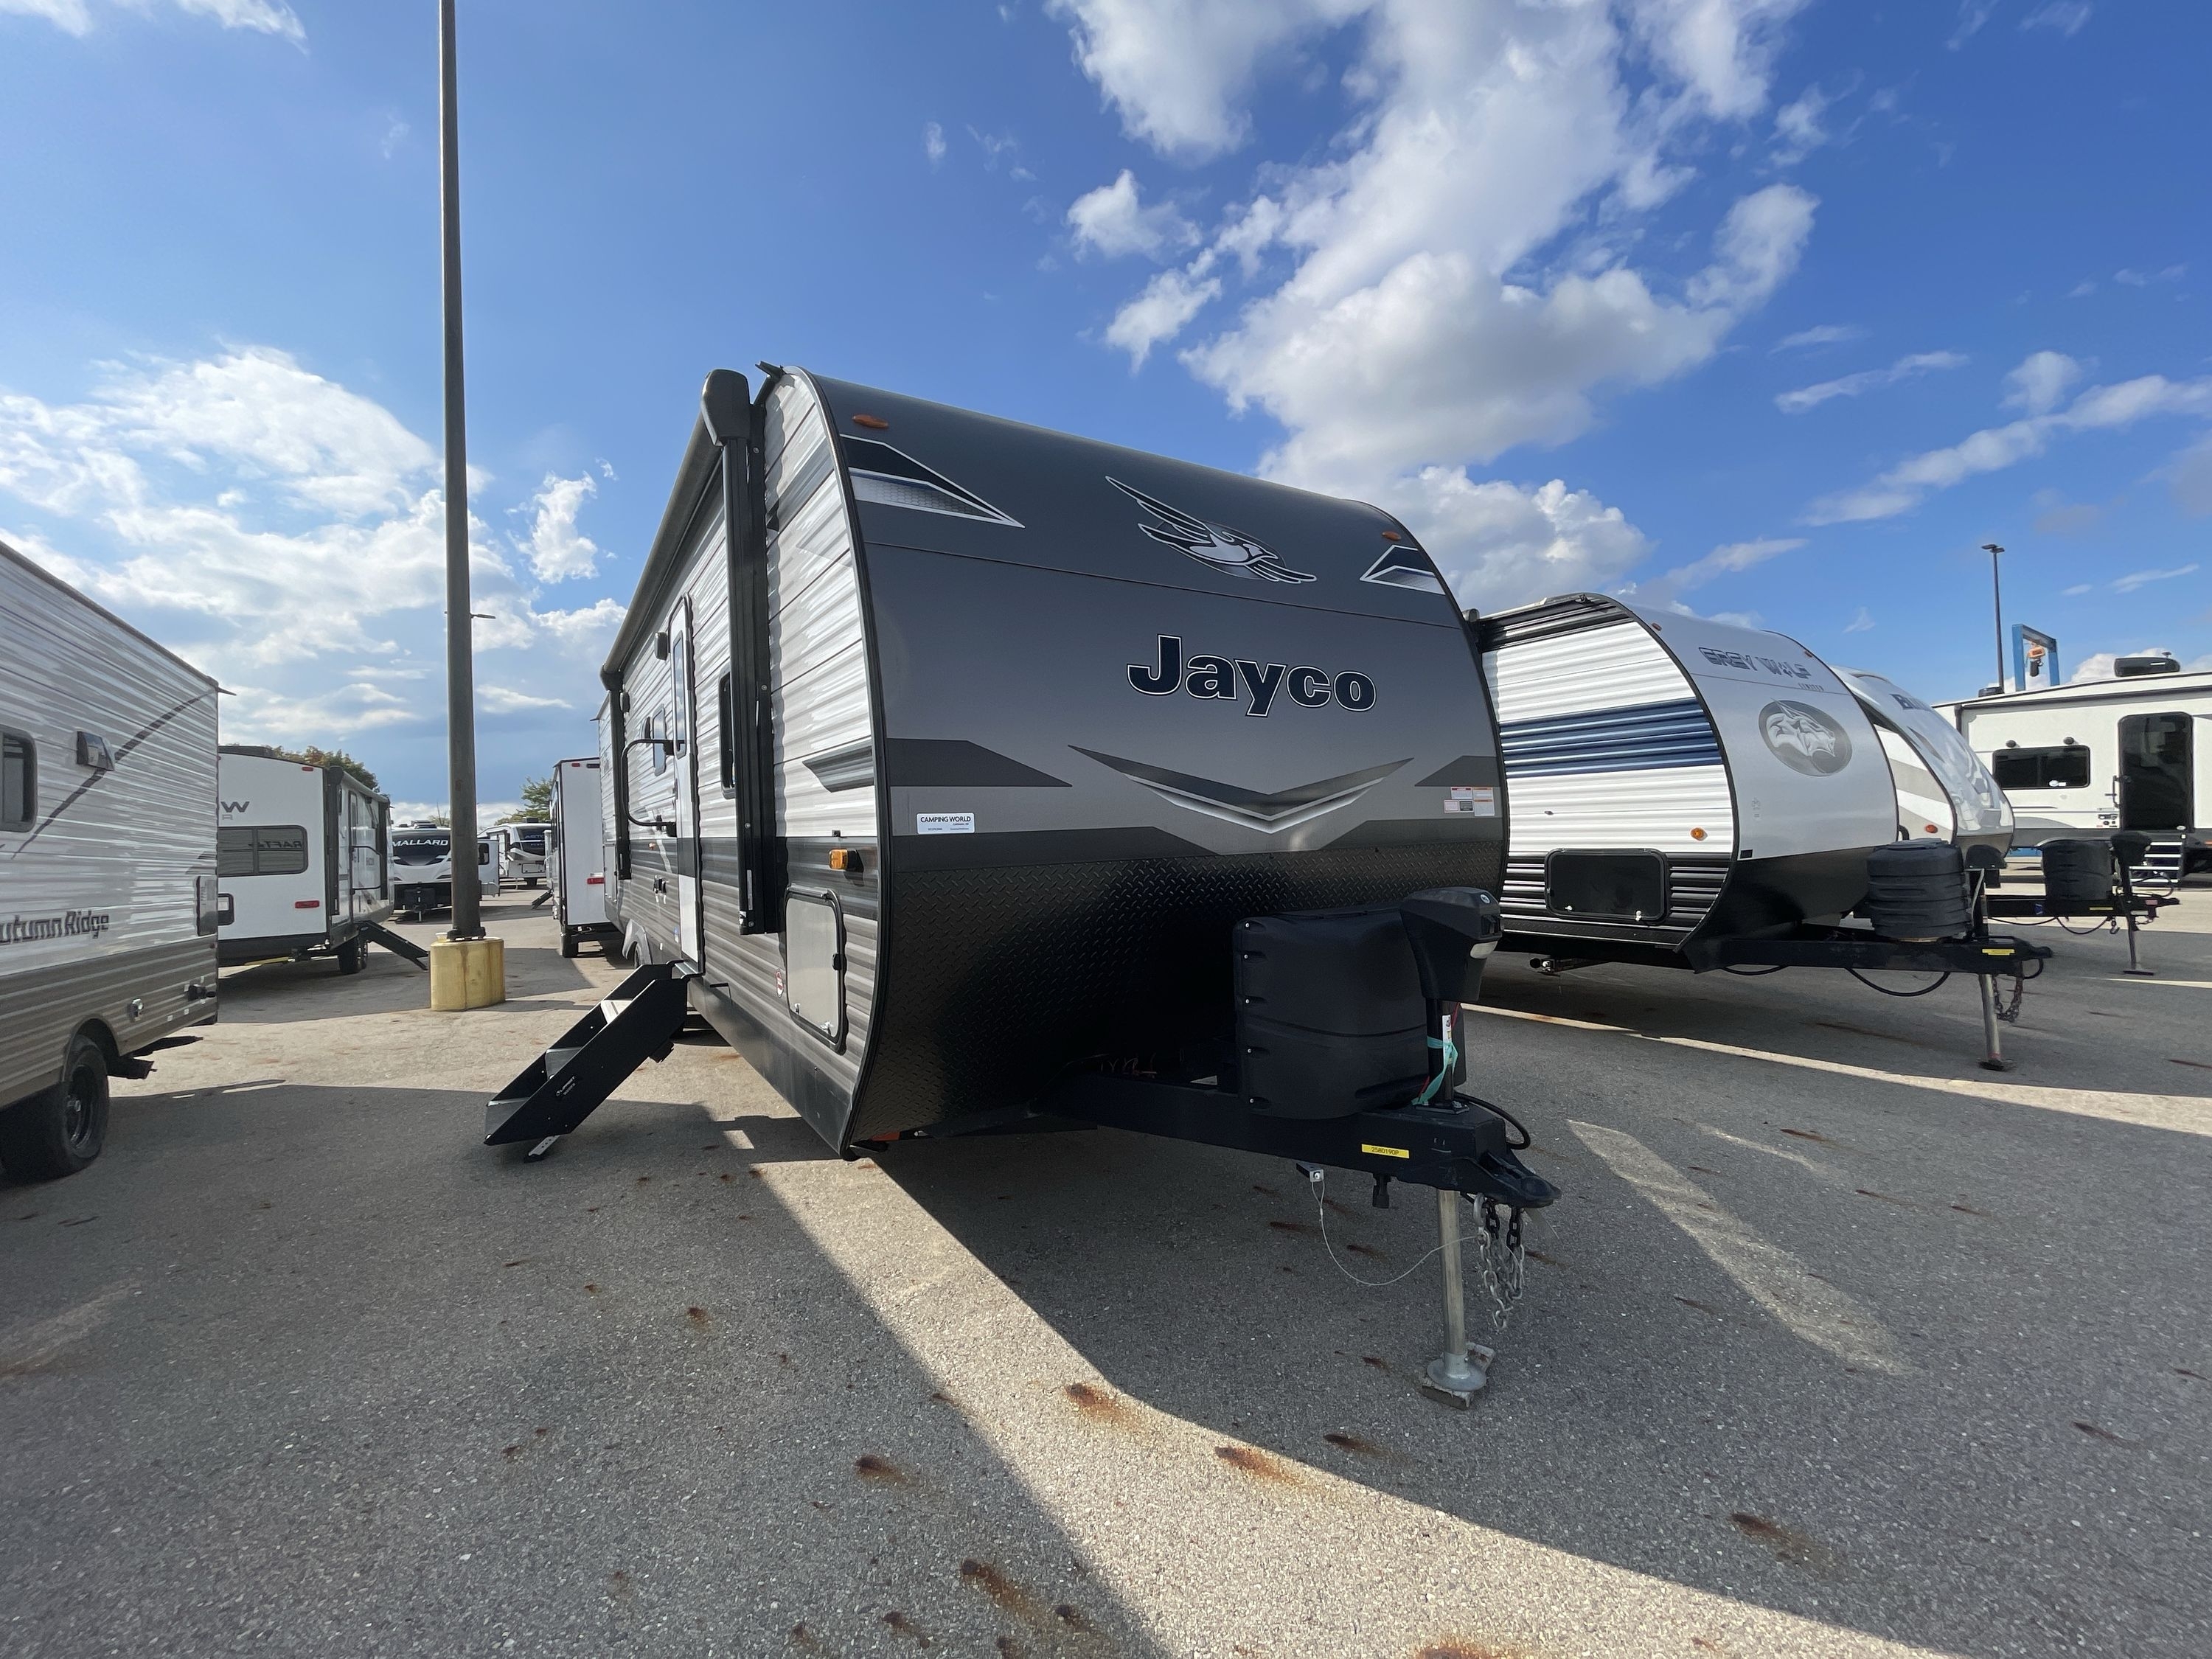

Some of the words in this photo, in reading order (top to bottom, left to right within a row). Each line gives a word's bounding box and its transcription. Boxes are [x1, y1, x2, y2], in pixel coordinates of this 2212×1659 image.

[1698, 647, 1758, 672] GREY
[1127, 633, 1377, 717] Jayco
[392, 838, 449, 847] MALLARD
[0, 915, 62, 945] utumn
[65, 911, 110, 939] Ridge
